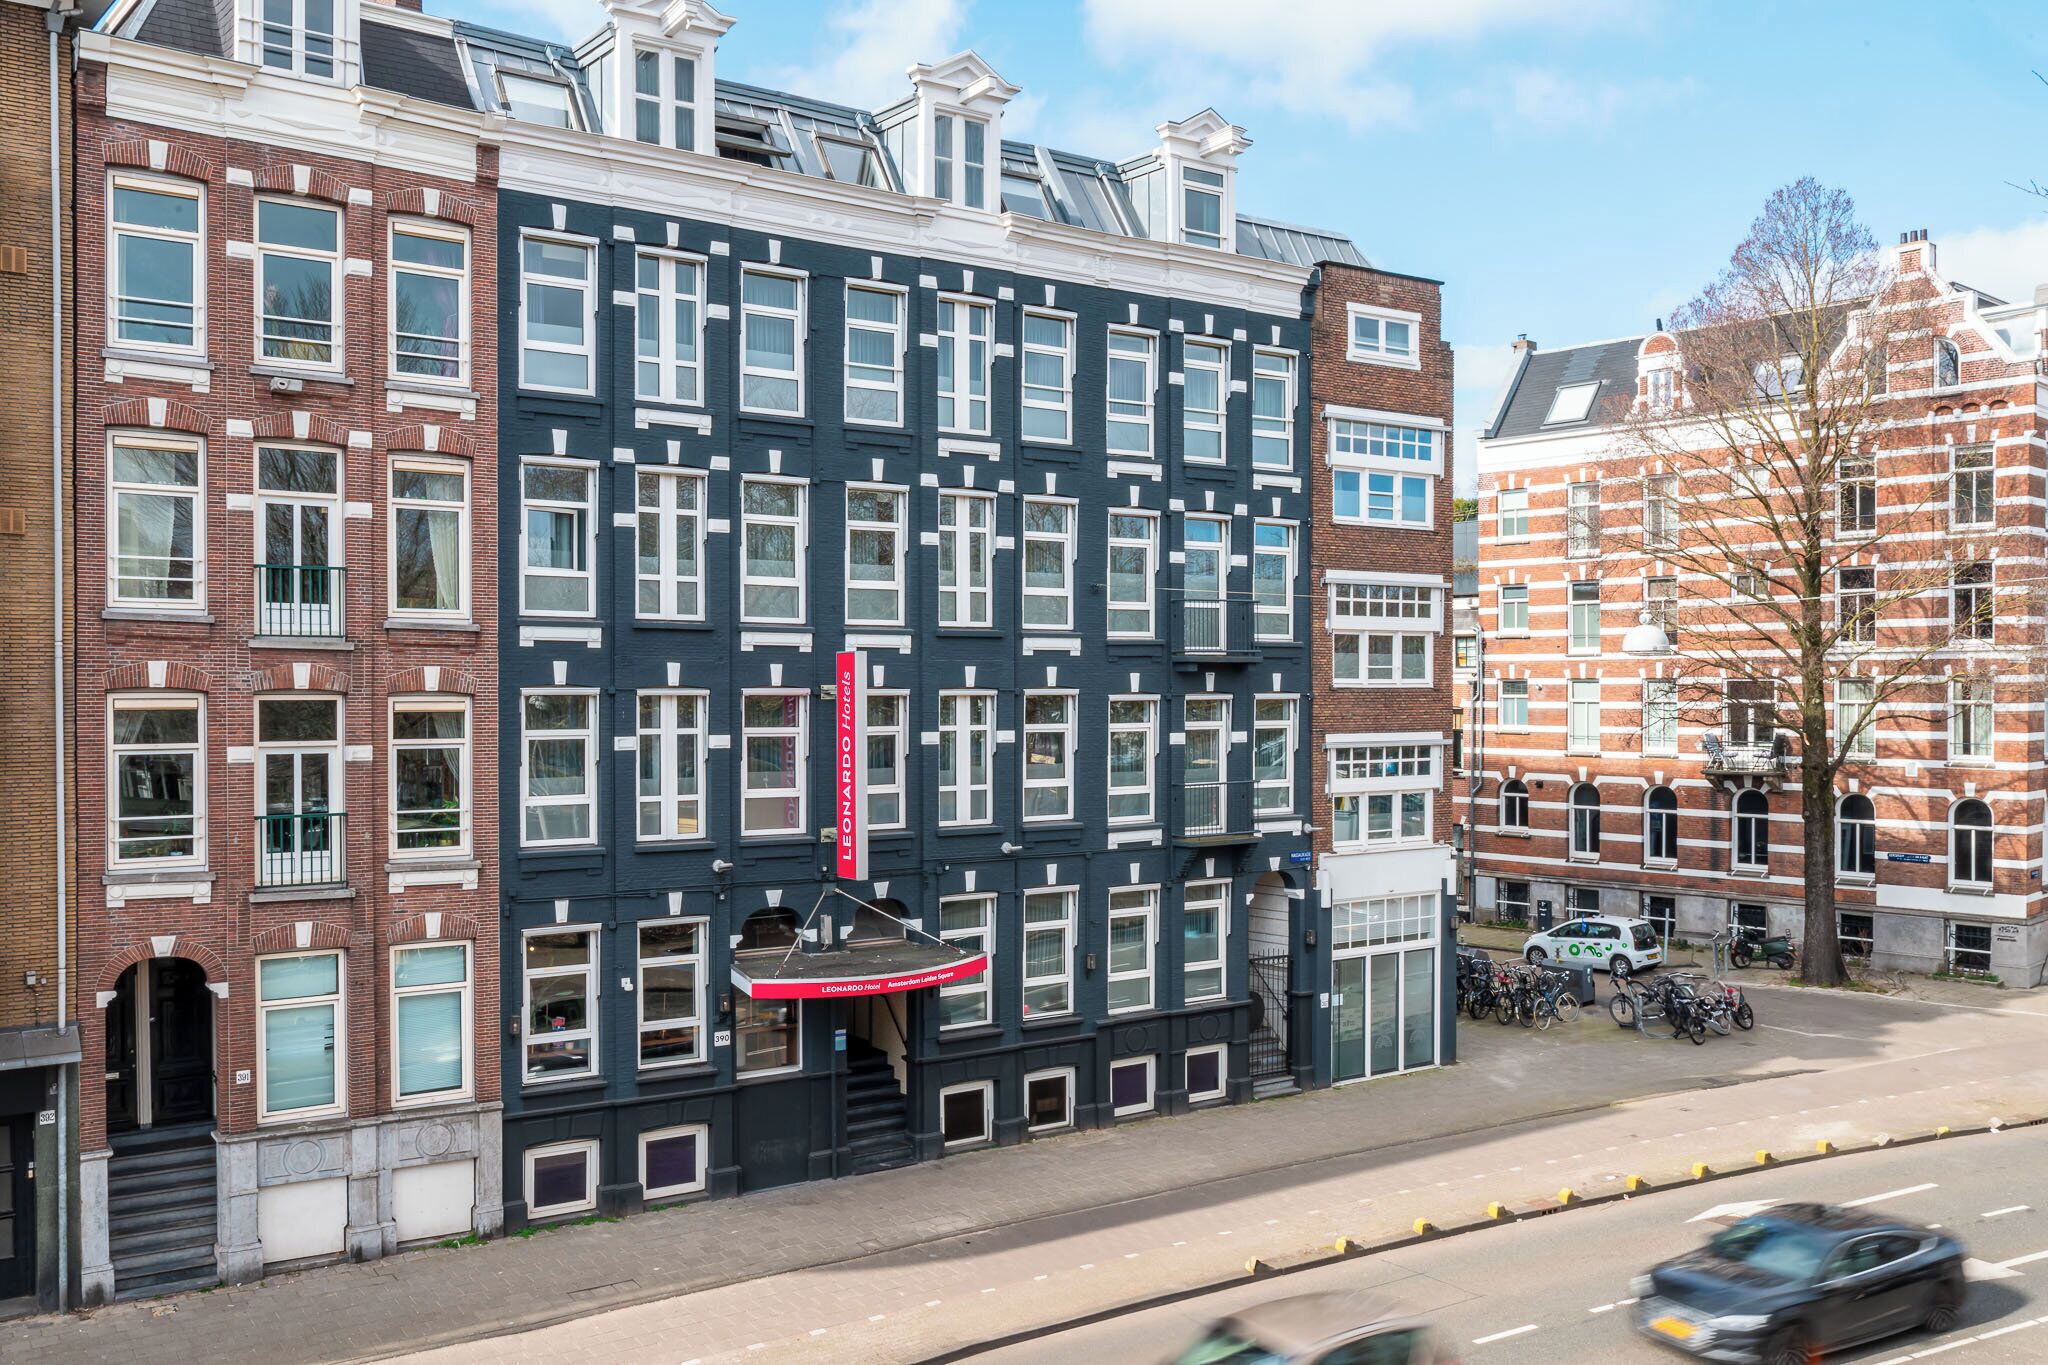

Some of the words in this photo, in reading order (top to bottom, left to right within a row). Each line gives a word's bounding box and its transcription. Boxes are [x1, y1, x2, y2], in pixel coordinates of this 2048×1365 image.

[842, 671, 851, 731] Hotels
[842, 736, 852, 860] LEONARDO
[822, 985, 863, 993] LEONARDO
[864, 983, 880, 991] Hotel
[888, 978, 920, 988] Amsterdam
[938, 972, 953, 980] Square
[715, 1034, 729, 1042] 390
[237, 1072, 249, 1082] 391
[40, 1112, 55, 1123] 392
